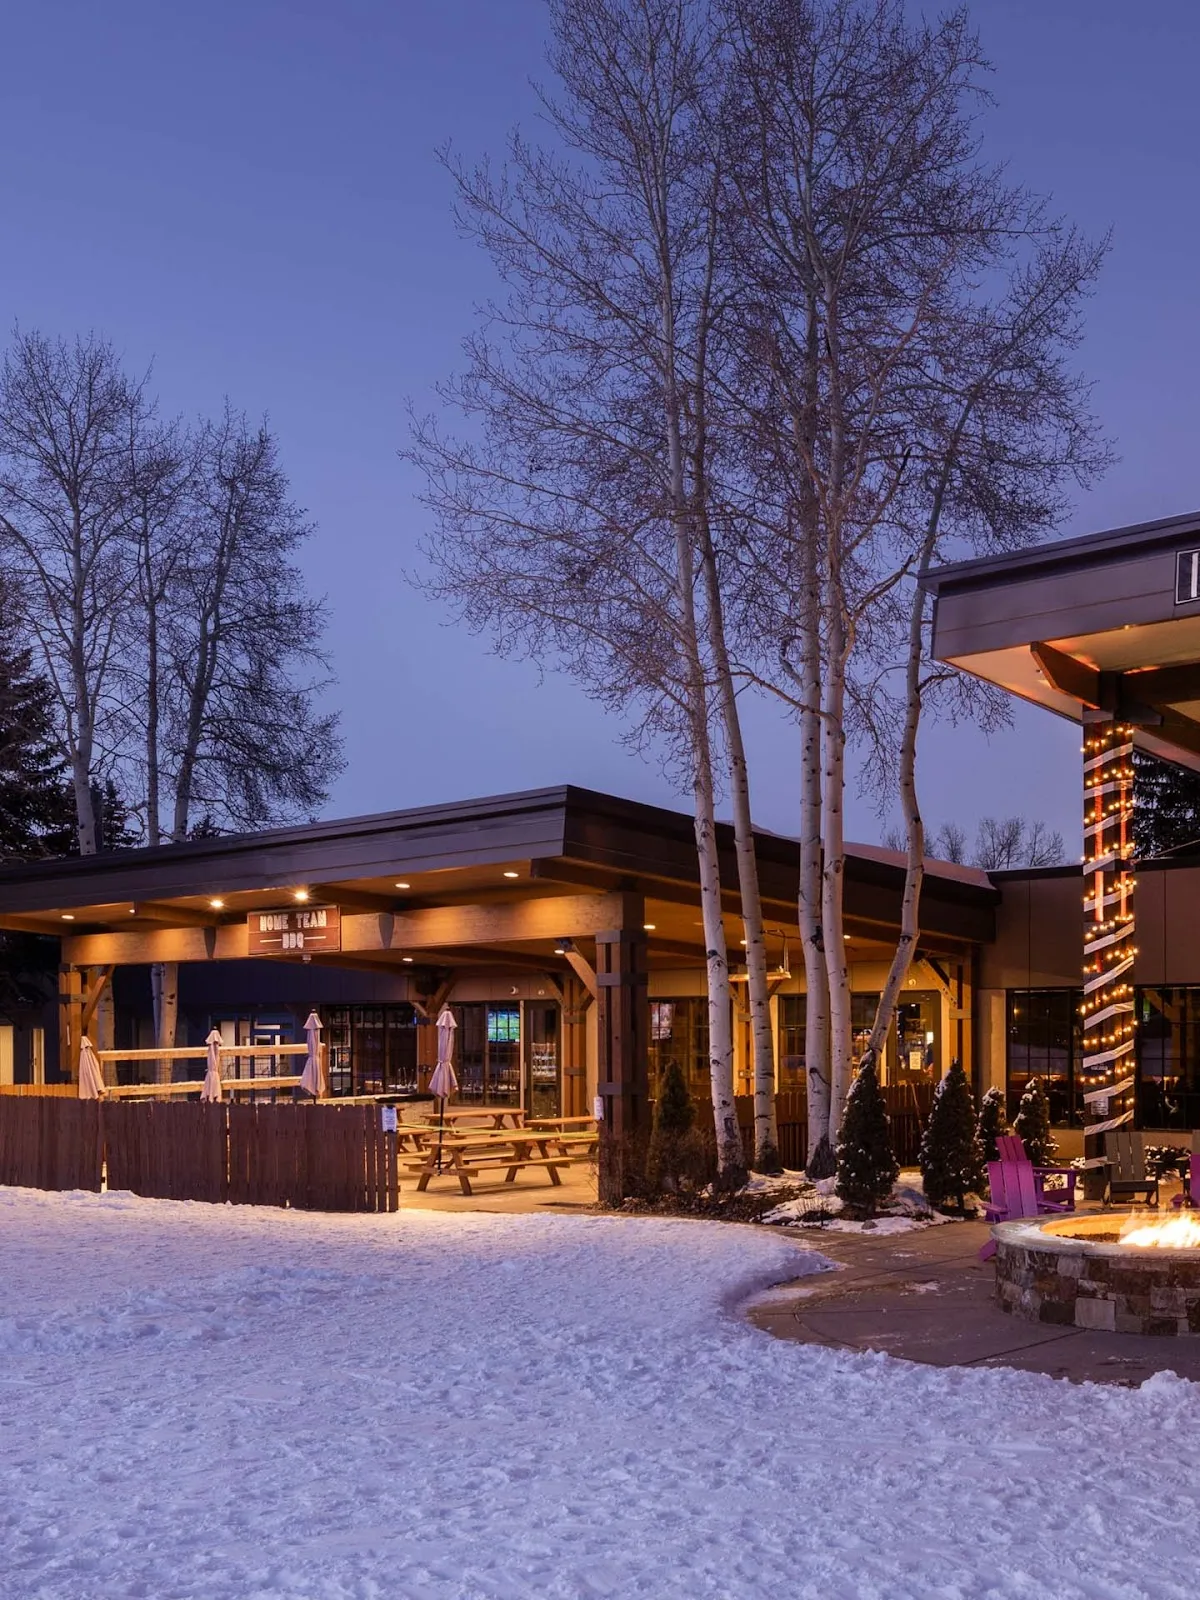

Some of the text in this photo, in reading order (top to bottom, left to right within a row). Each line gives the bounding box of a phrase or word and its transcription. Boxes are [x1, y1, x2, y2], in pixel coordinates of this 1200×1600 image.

[260, 910, 327, 931] HOME TEAM
[282, 931, 304, 949] BBQ
